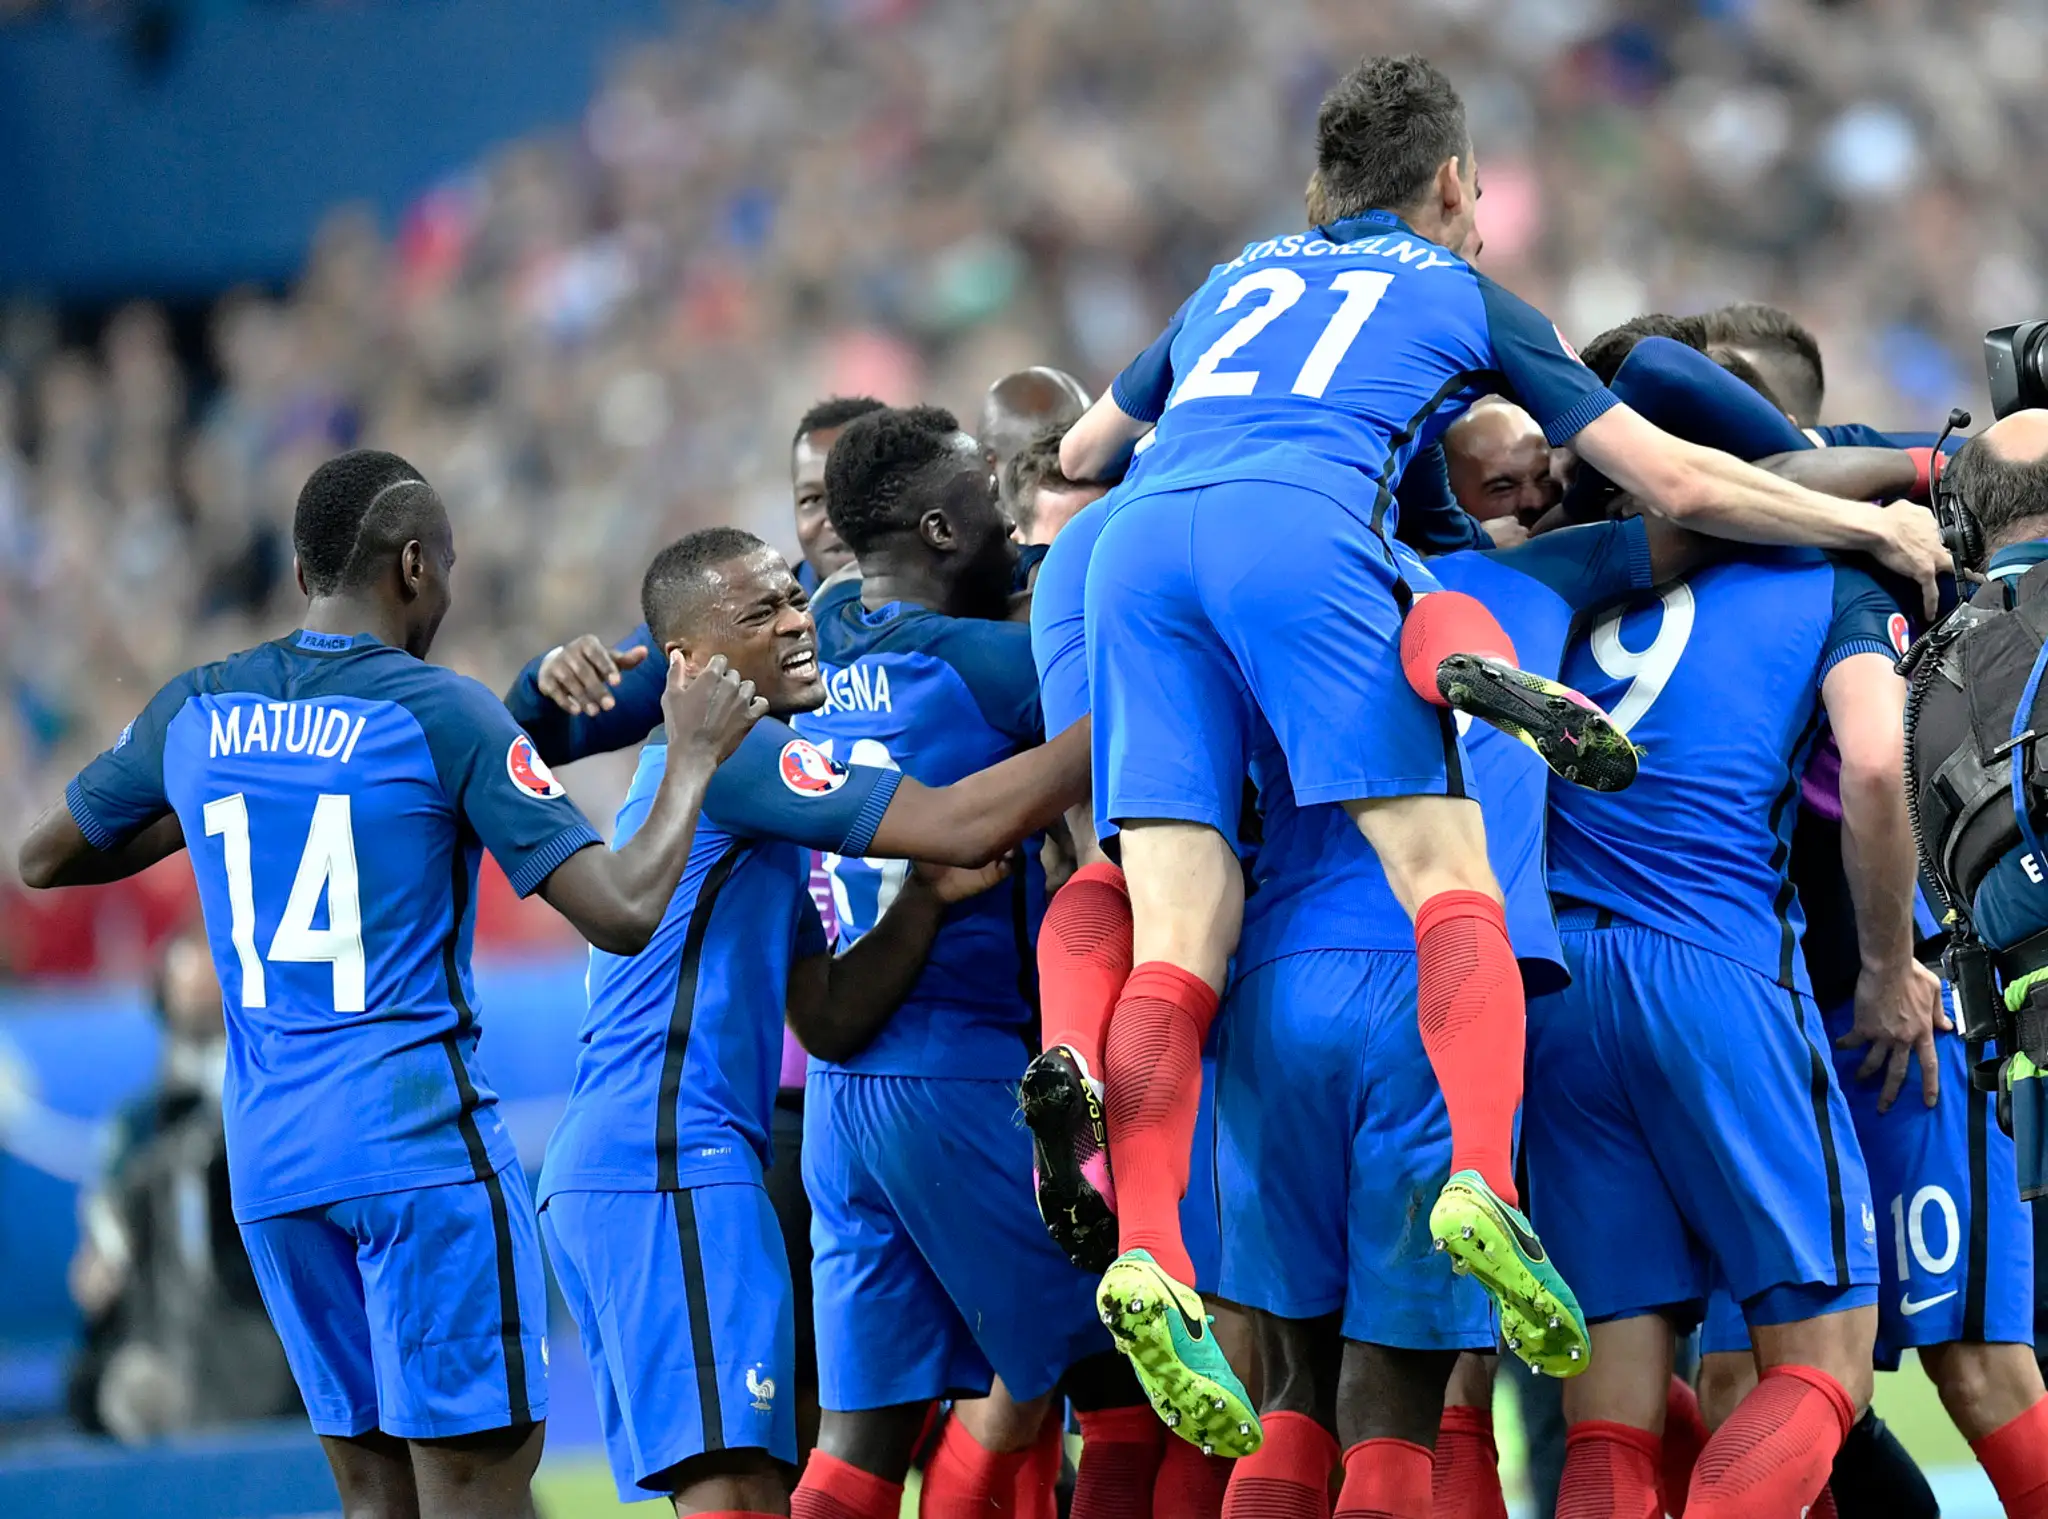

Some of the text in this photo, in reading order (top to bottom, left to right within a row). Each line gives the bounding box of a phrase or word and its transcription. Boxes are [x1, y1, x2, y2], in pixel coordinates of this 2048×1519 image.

[1223, 235, 1452, 275] KOSCIELNY
[1168, 267, 1396, 409] 21
[304, 635, 346, 649] FRANCE
[1590, 579, 1695, 735] 9
[209, 703, 366, 764] MATUIDI
[203, 793, 365, 1011] 14
[2020, 850, 2048, 884] E
[1891, 1185, 1960, 1281] 10
